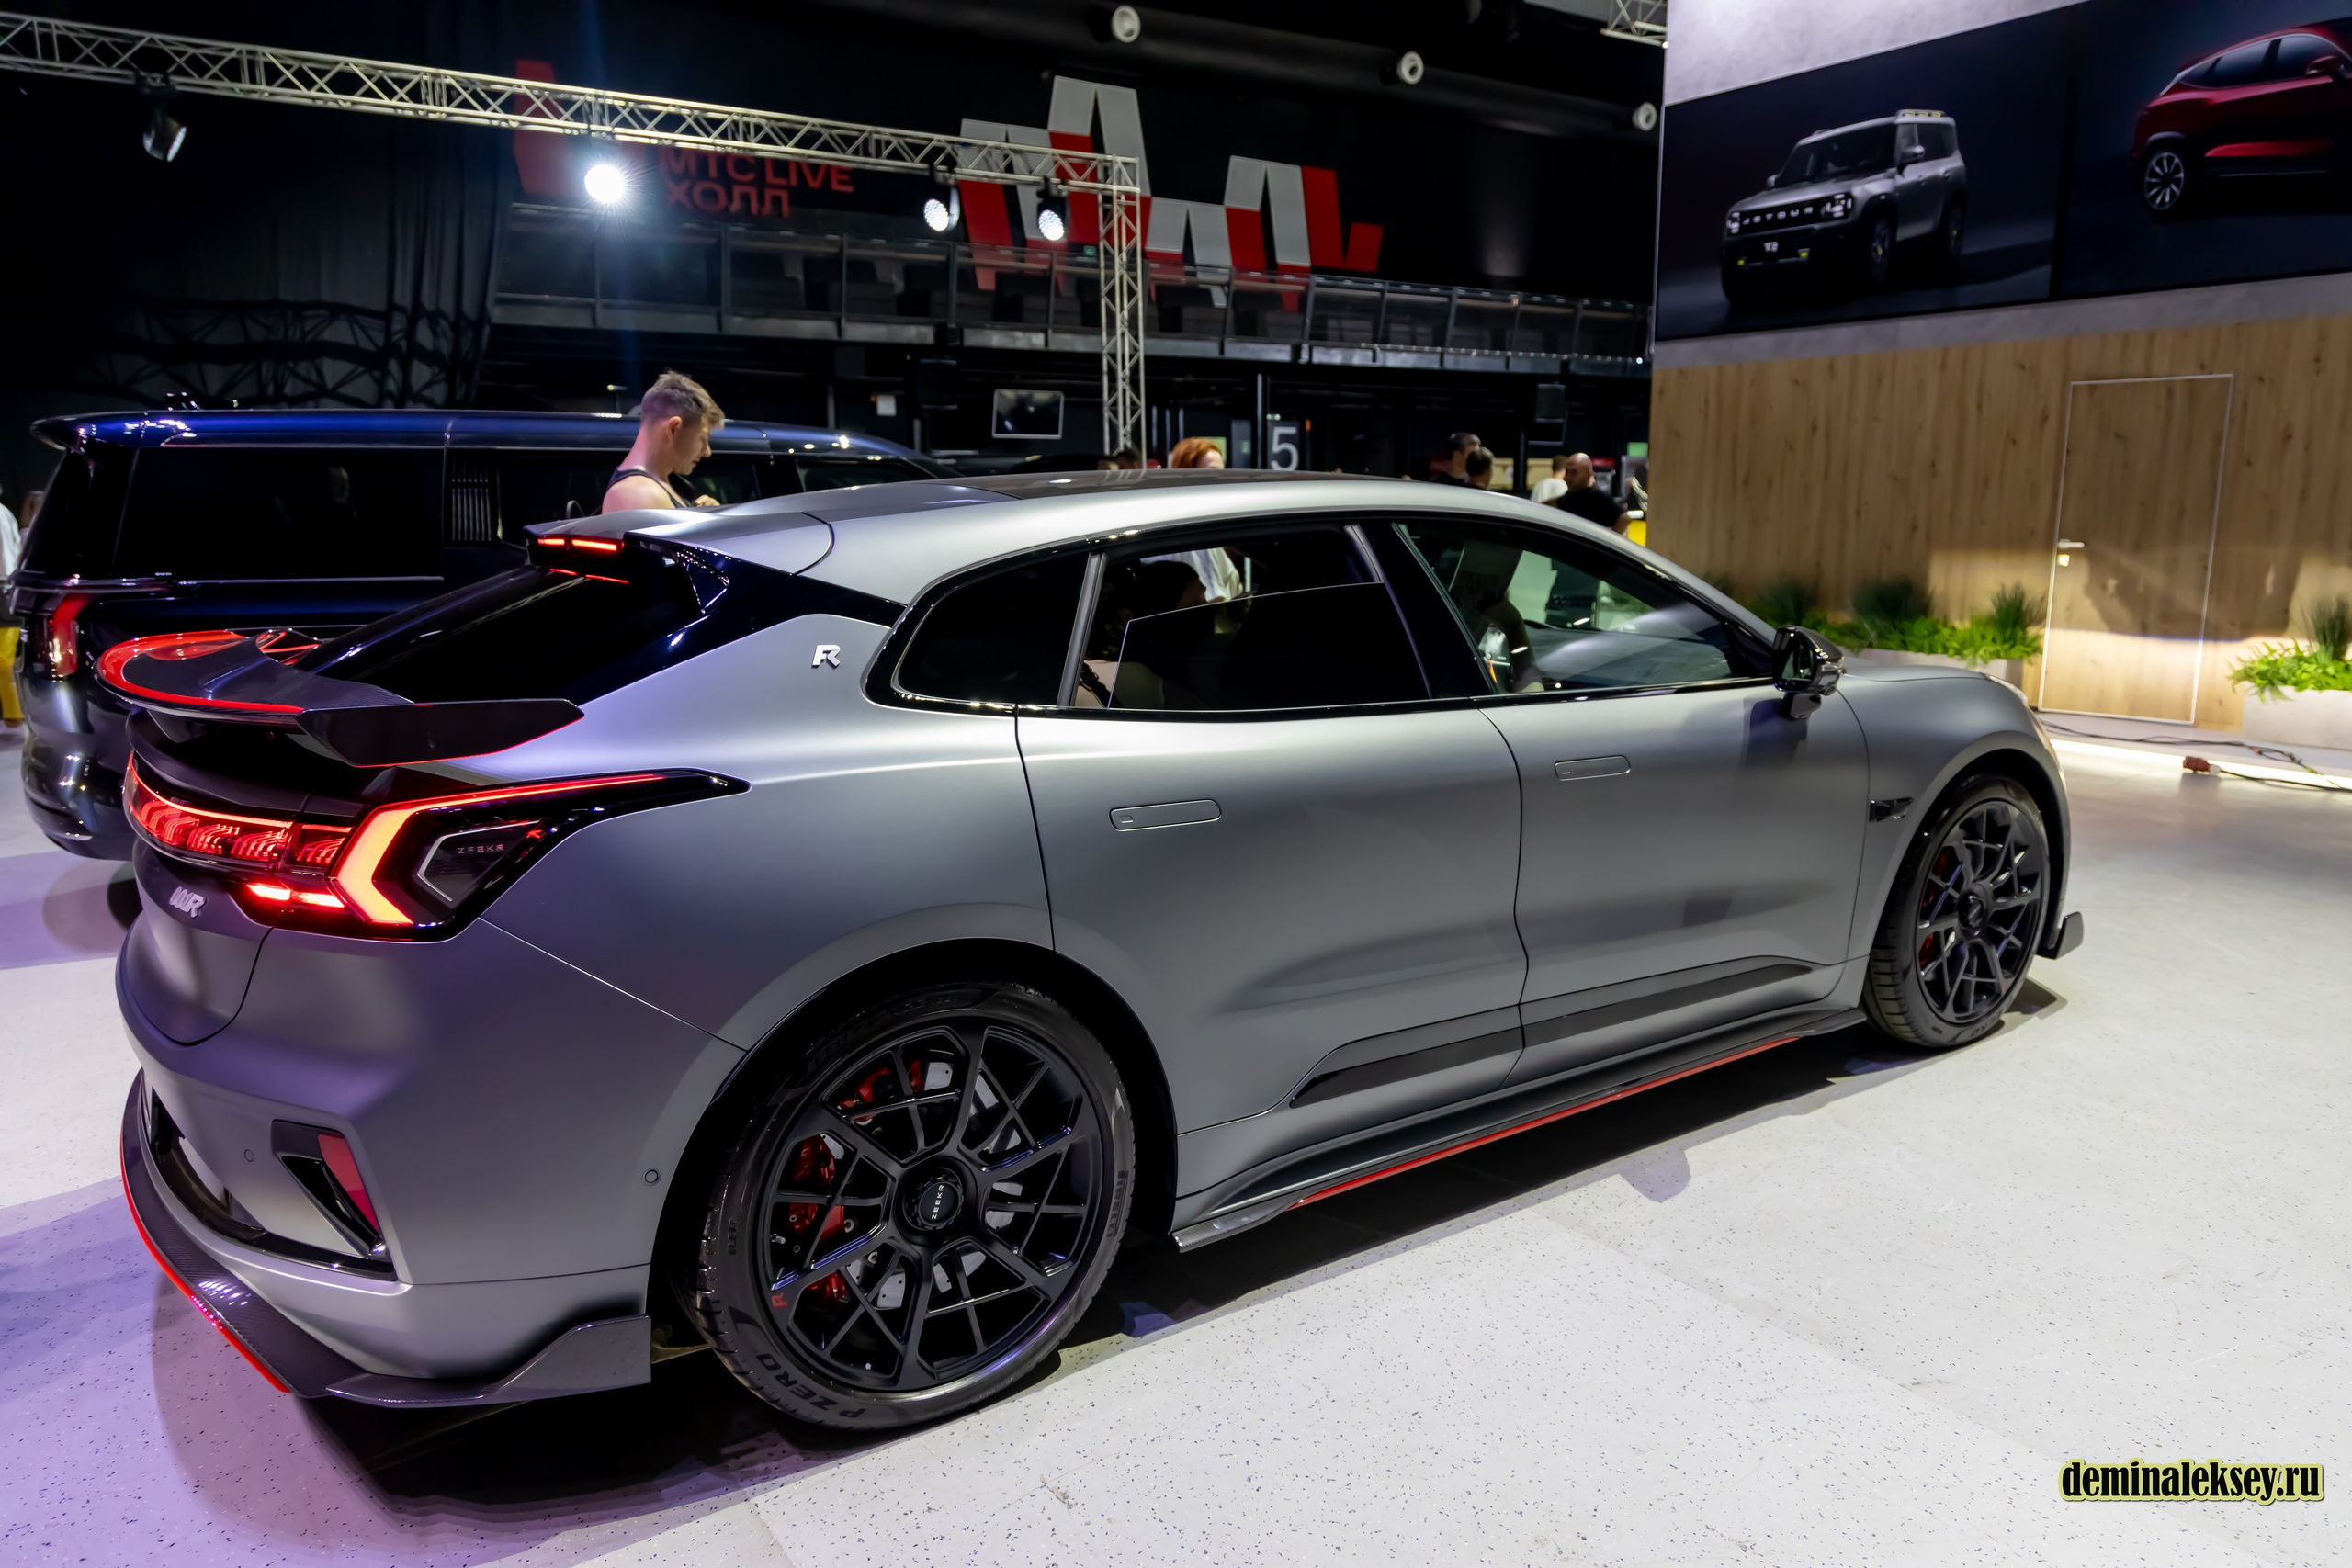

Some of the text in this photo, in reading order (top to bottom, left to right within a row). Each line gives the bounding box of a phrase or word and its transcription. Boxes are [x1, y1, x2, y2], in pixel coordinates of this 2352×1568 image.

[764, 156, 855, 194] LIVE
[666, 178, 790, 218] ХОЛЛ
[1742, 207, 1814, 225] JETOUR
[1271, 426, 1299, 472] 5
[457, 843, 504, 855] ZEEKR
[931, 1184, 944, 1220] ZEEKR
[771, 1292, 788, 1309] R
